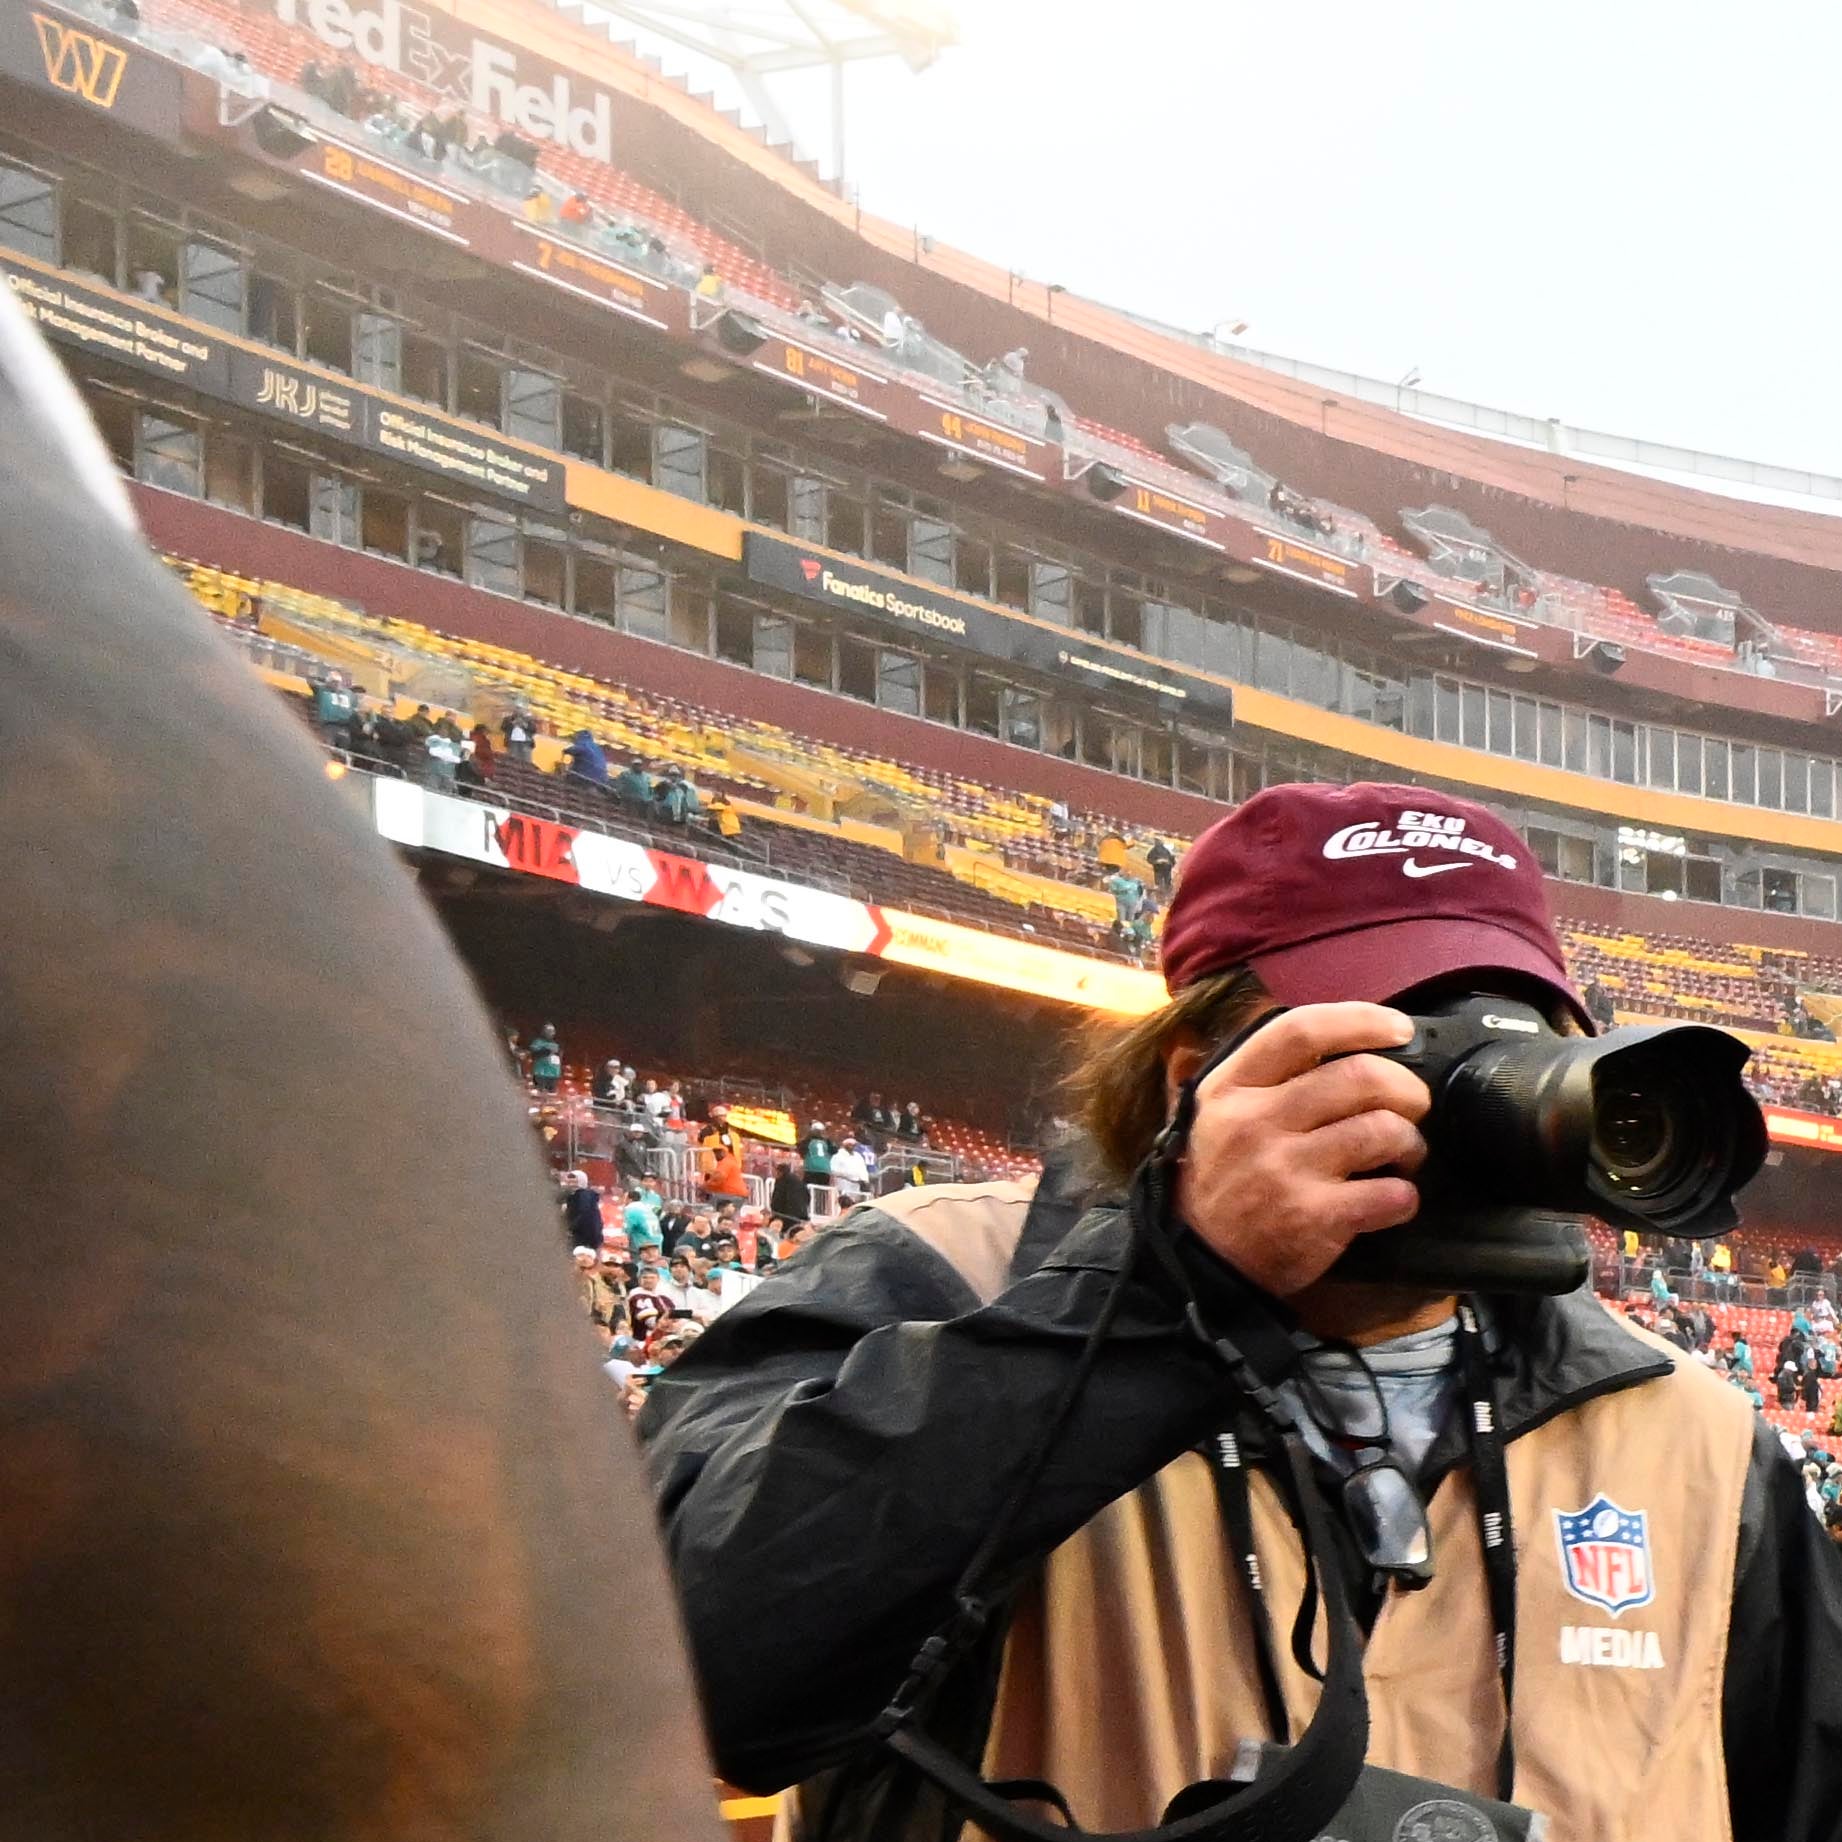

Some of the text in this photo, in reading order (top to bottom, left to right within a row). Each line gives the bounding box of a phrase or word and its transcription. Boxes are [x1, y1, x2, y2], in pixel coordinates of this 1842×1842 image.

[822, 570, 966, 635] Fanatics Sportsbook
[1323, 822, 1517, 869] COLONELS
[1397, 811, 1466, 832] EKU
[484, 810, 579, 877] MIA
[658, 860, 790, 936] WAS
[1569, 1545, 1645, 1599] NFL
[1559, 1626, 1664, 1670] MEDIA
